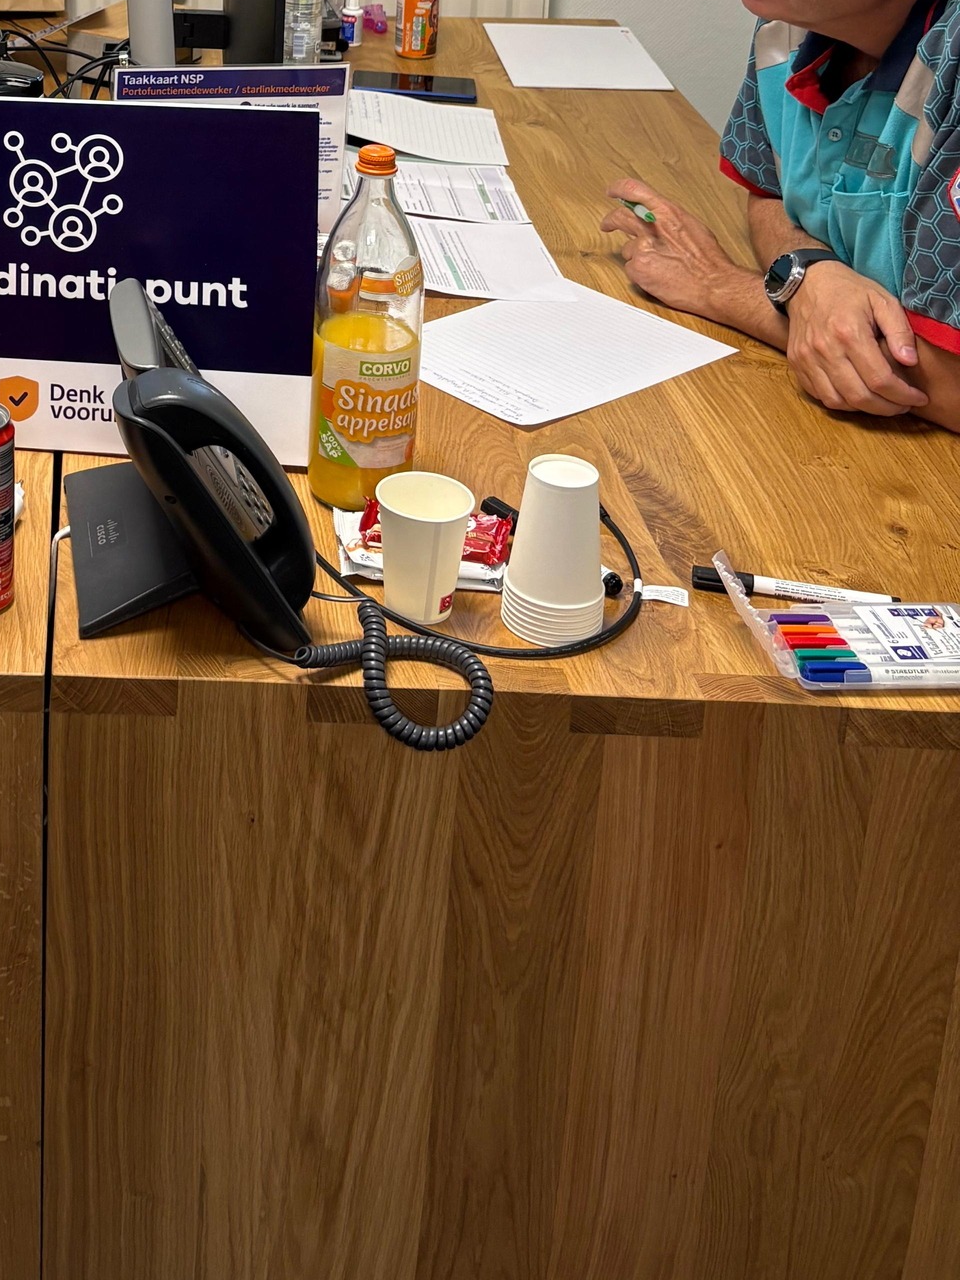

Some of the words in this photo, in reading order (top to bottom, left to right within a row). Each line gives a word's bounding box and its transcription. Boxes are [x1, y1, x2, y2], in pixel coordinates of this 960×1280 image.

[122, 74, 179, 86] Taakkaart
[180, 73, 205, 85] NSP
[122, 85, 233, 97] Portofunctiemedewerker
[241, 84, 331, 95] starlinkmedewerker
[361, 359, 410, 376] CORVO
[50, 383, 105, 405] Denk
[50, 405, 116, 422] vooru
[320, 432, 339, 459] SAP
